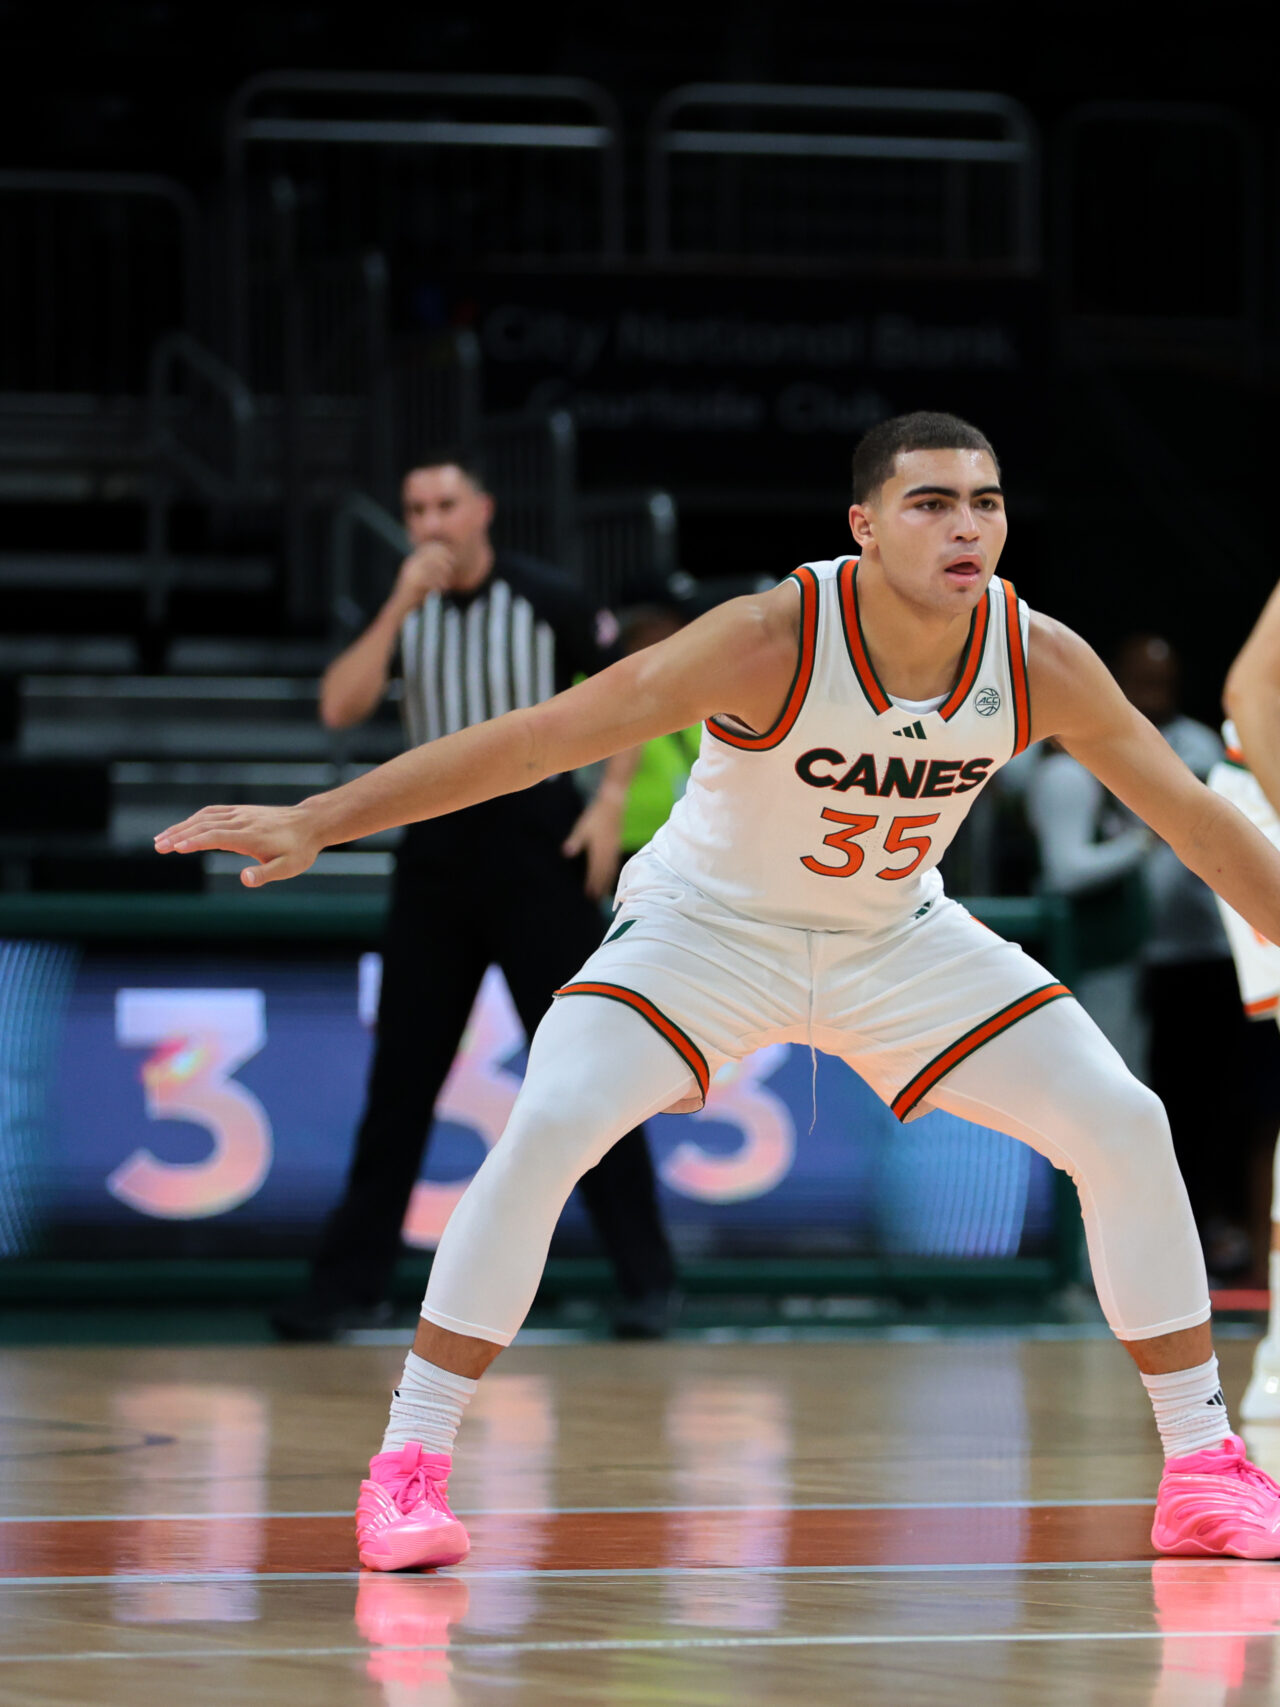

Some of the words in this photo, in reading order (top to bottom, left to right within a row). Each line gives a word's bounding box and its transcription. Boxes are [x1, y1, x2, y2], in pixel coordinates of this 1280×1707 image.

[795, 747, 994, 799] CANES
[800, 807, 941, 881] 35
[106, 988, 275, 1221] 3
